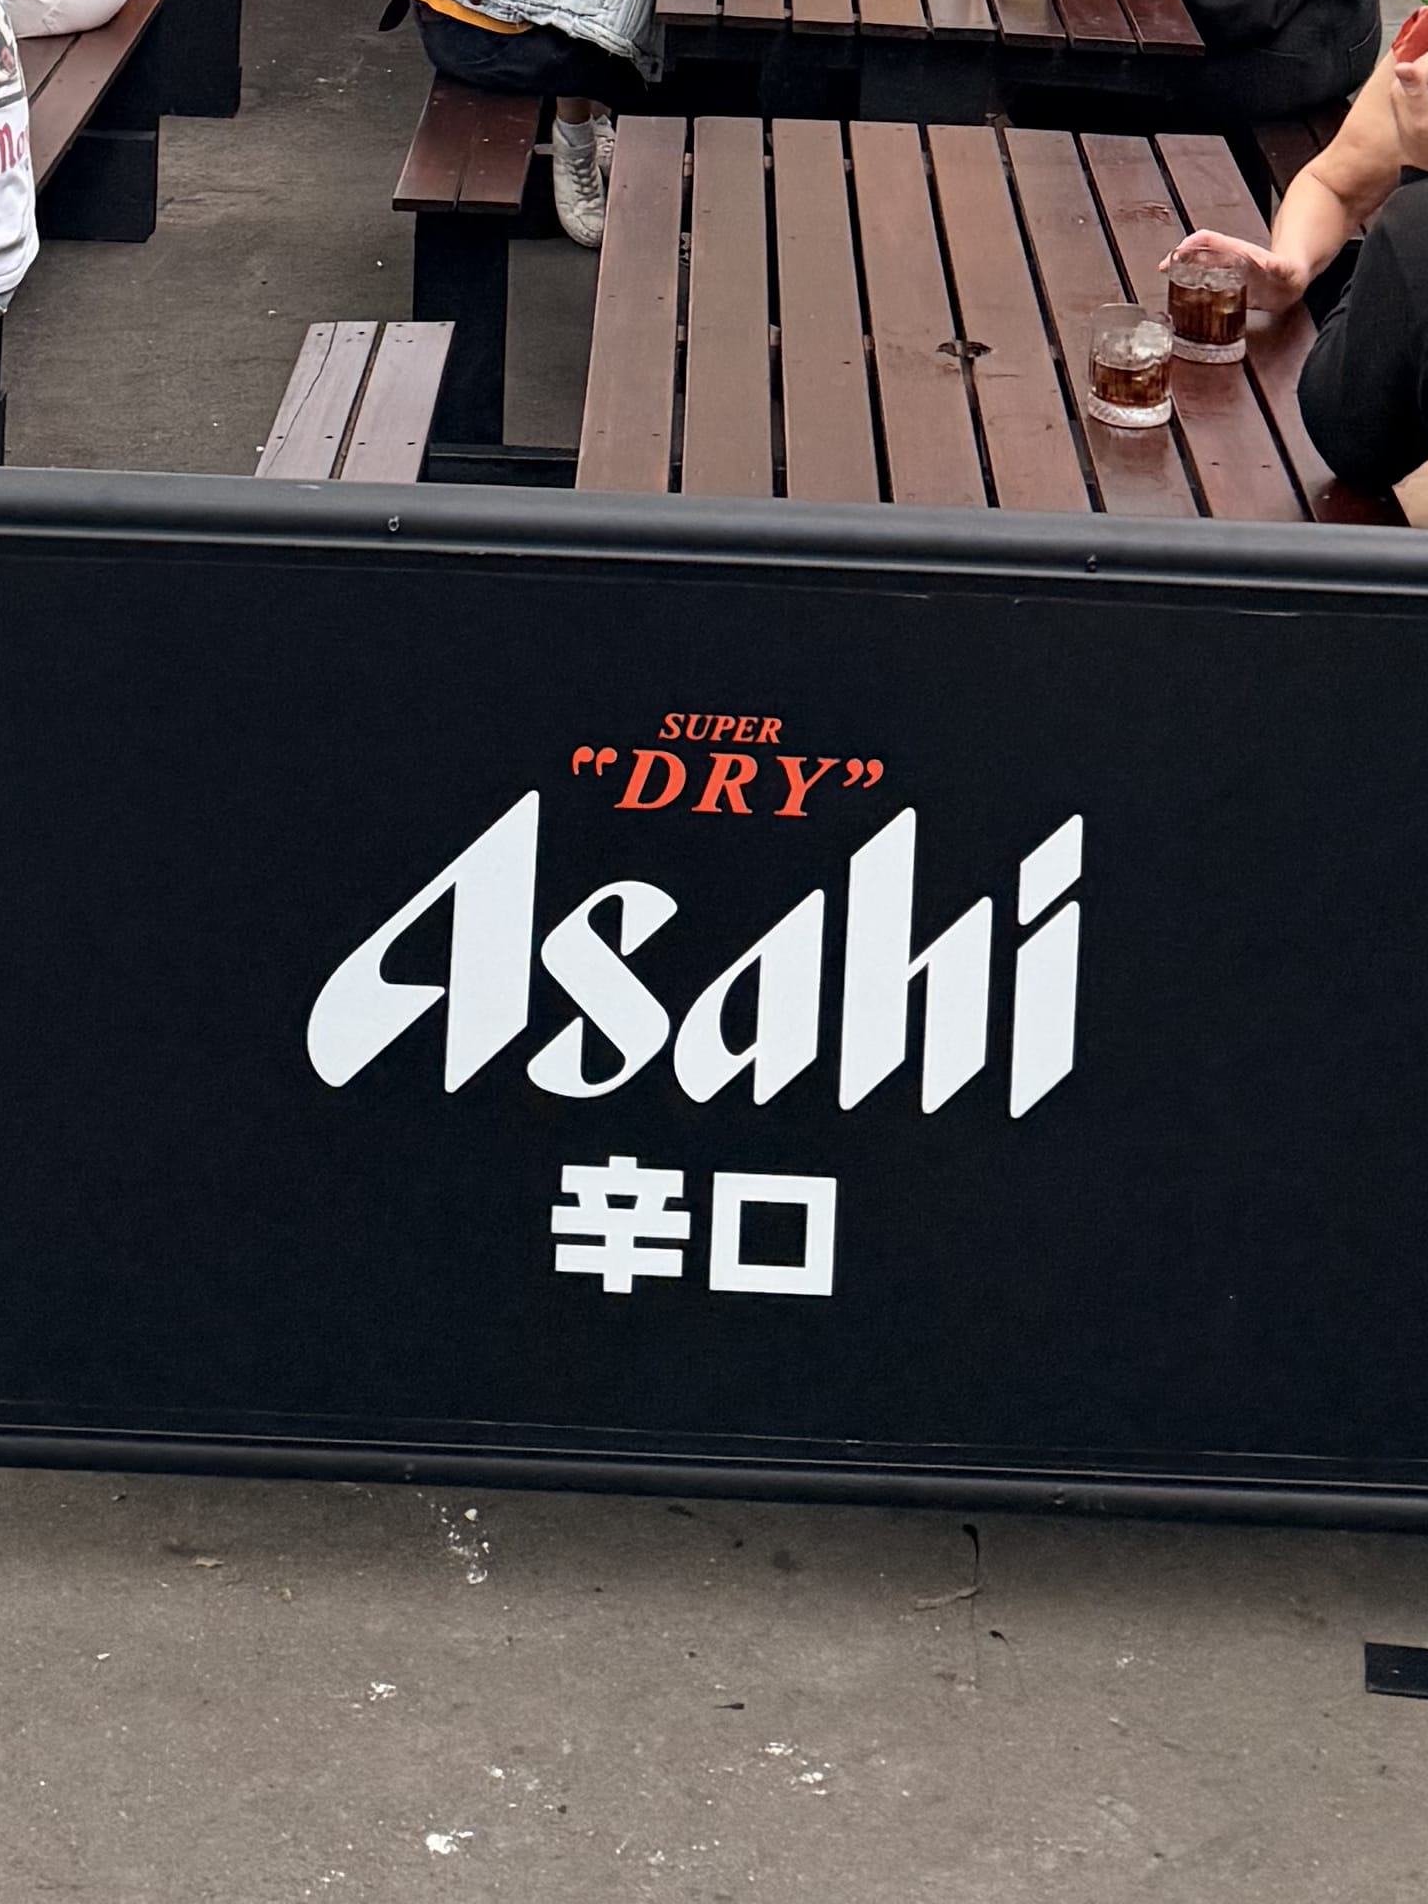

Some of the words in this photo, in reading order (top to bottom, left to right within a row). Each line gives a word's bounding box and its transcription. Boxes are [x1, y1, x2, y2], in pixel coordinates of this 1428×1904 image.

[658, 712, 783, 745] SUPER
[306, 790, 1083, 1119] Asahi
[551, 1156, 837, 1297] 辛口
